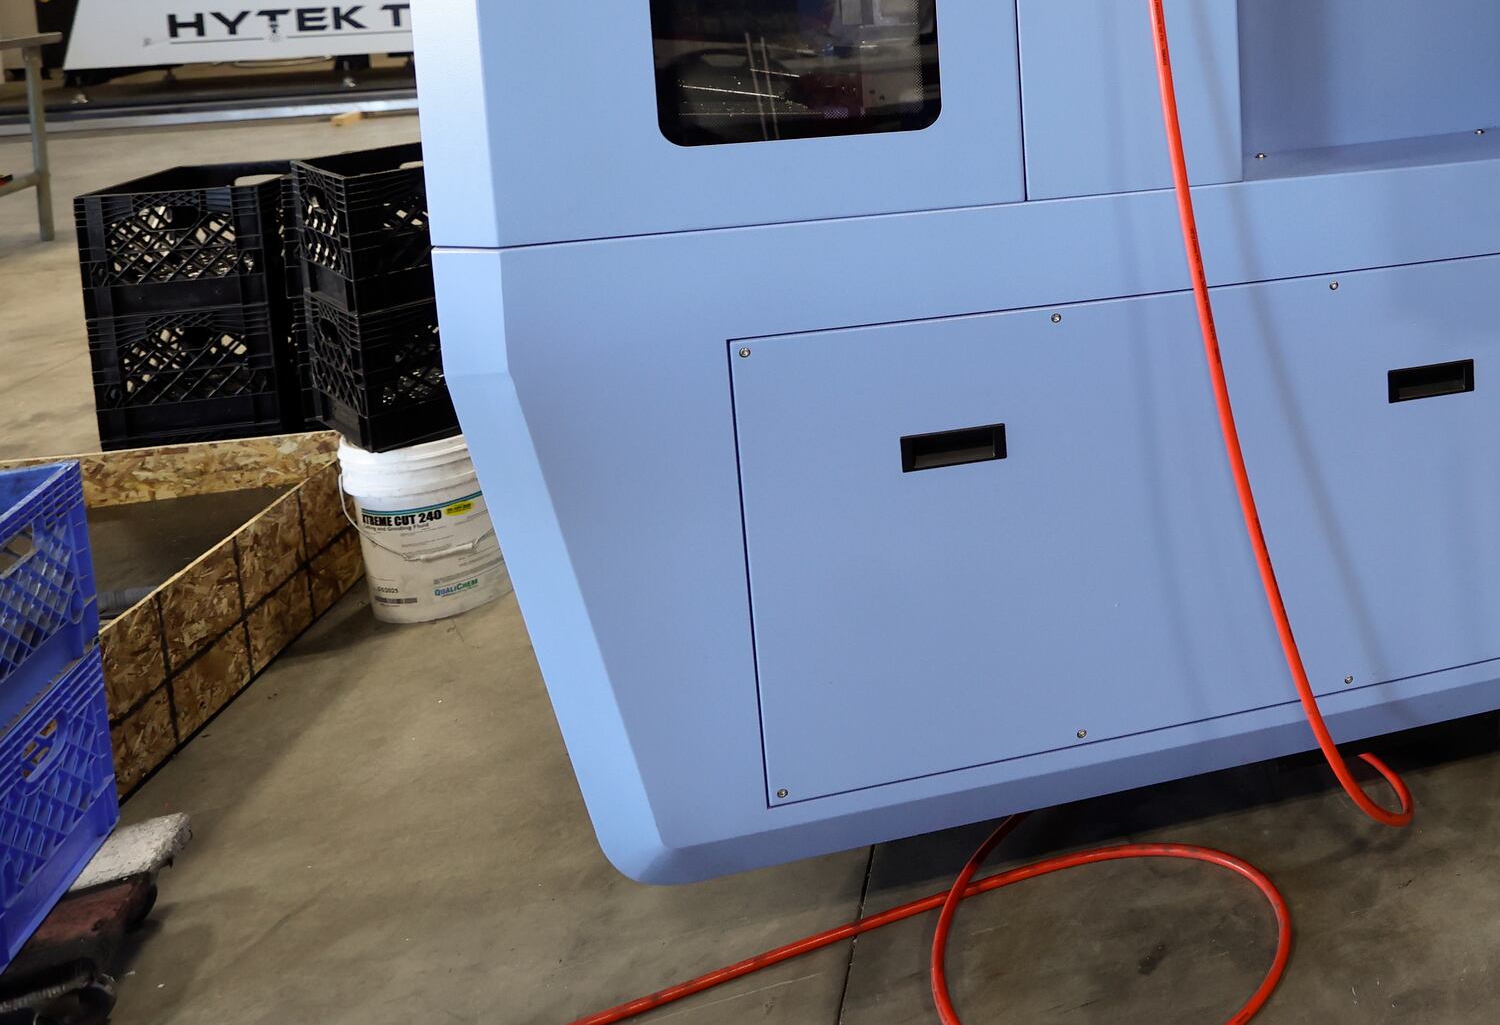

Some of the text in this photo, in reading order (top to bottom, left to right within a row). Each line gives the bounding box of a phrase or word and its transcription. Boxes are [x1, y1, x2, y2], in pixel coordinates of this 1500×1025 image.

[167, 4, 367, 39] HYTEK
[394, 514, 416, 526] CUT
[418, 509, 442, 523] 240
